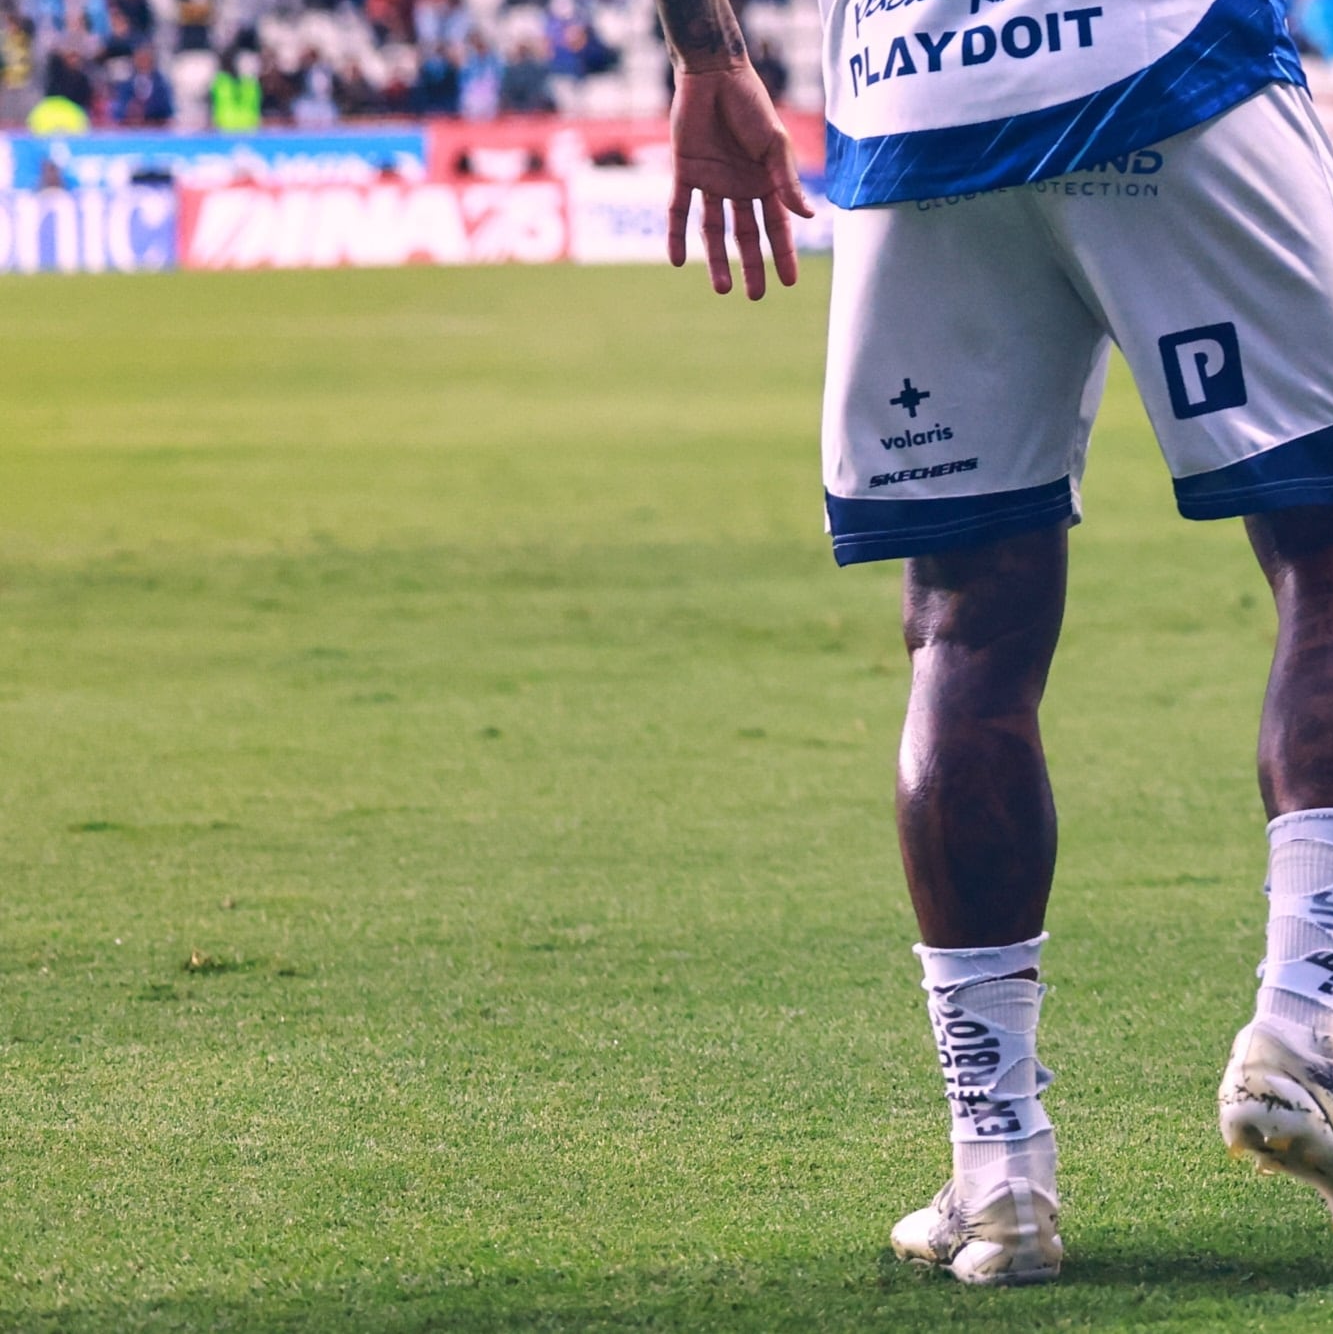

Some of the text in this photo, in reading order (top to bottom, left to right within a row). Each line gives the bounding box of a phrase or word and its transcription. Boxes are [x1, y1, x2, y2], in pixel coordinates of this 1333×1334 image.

[849, 6, 1103, 97] PLAYDOIT
[880, 422, 954, 451] volaris
[868, 457, 979, 489] SKECHERS
